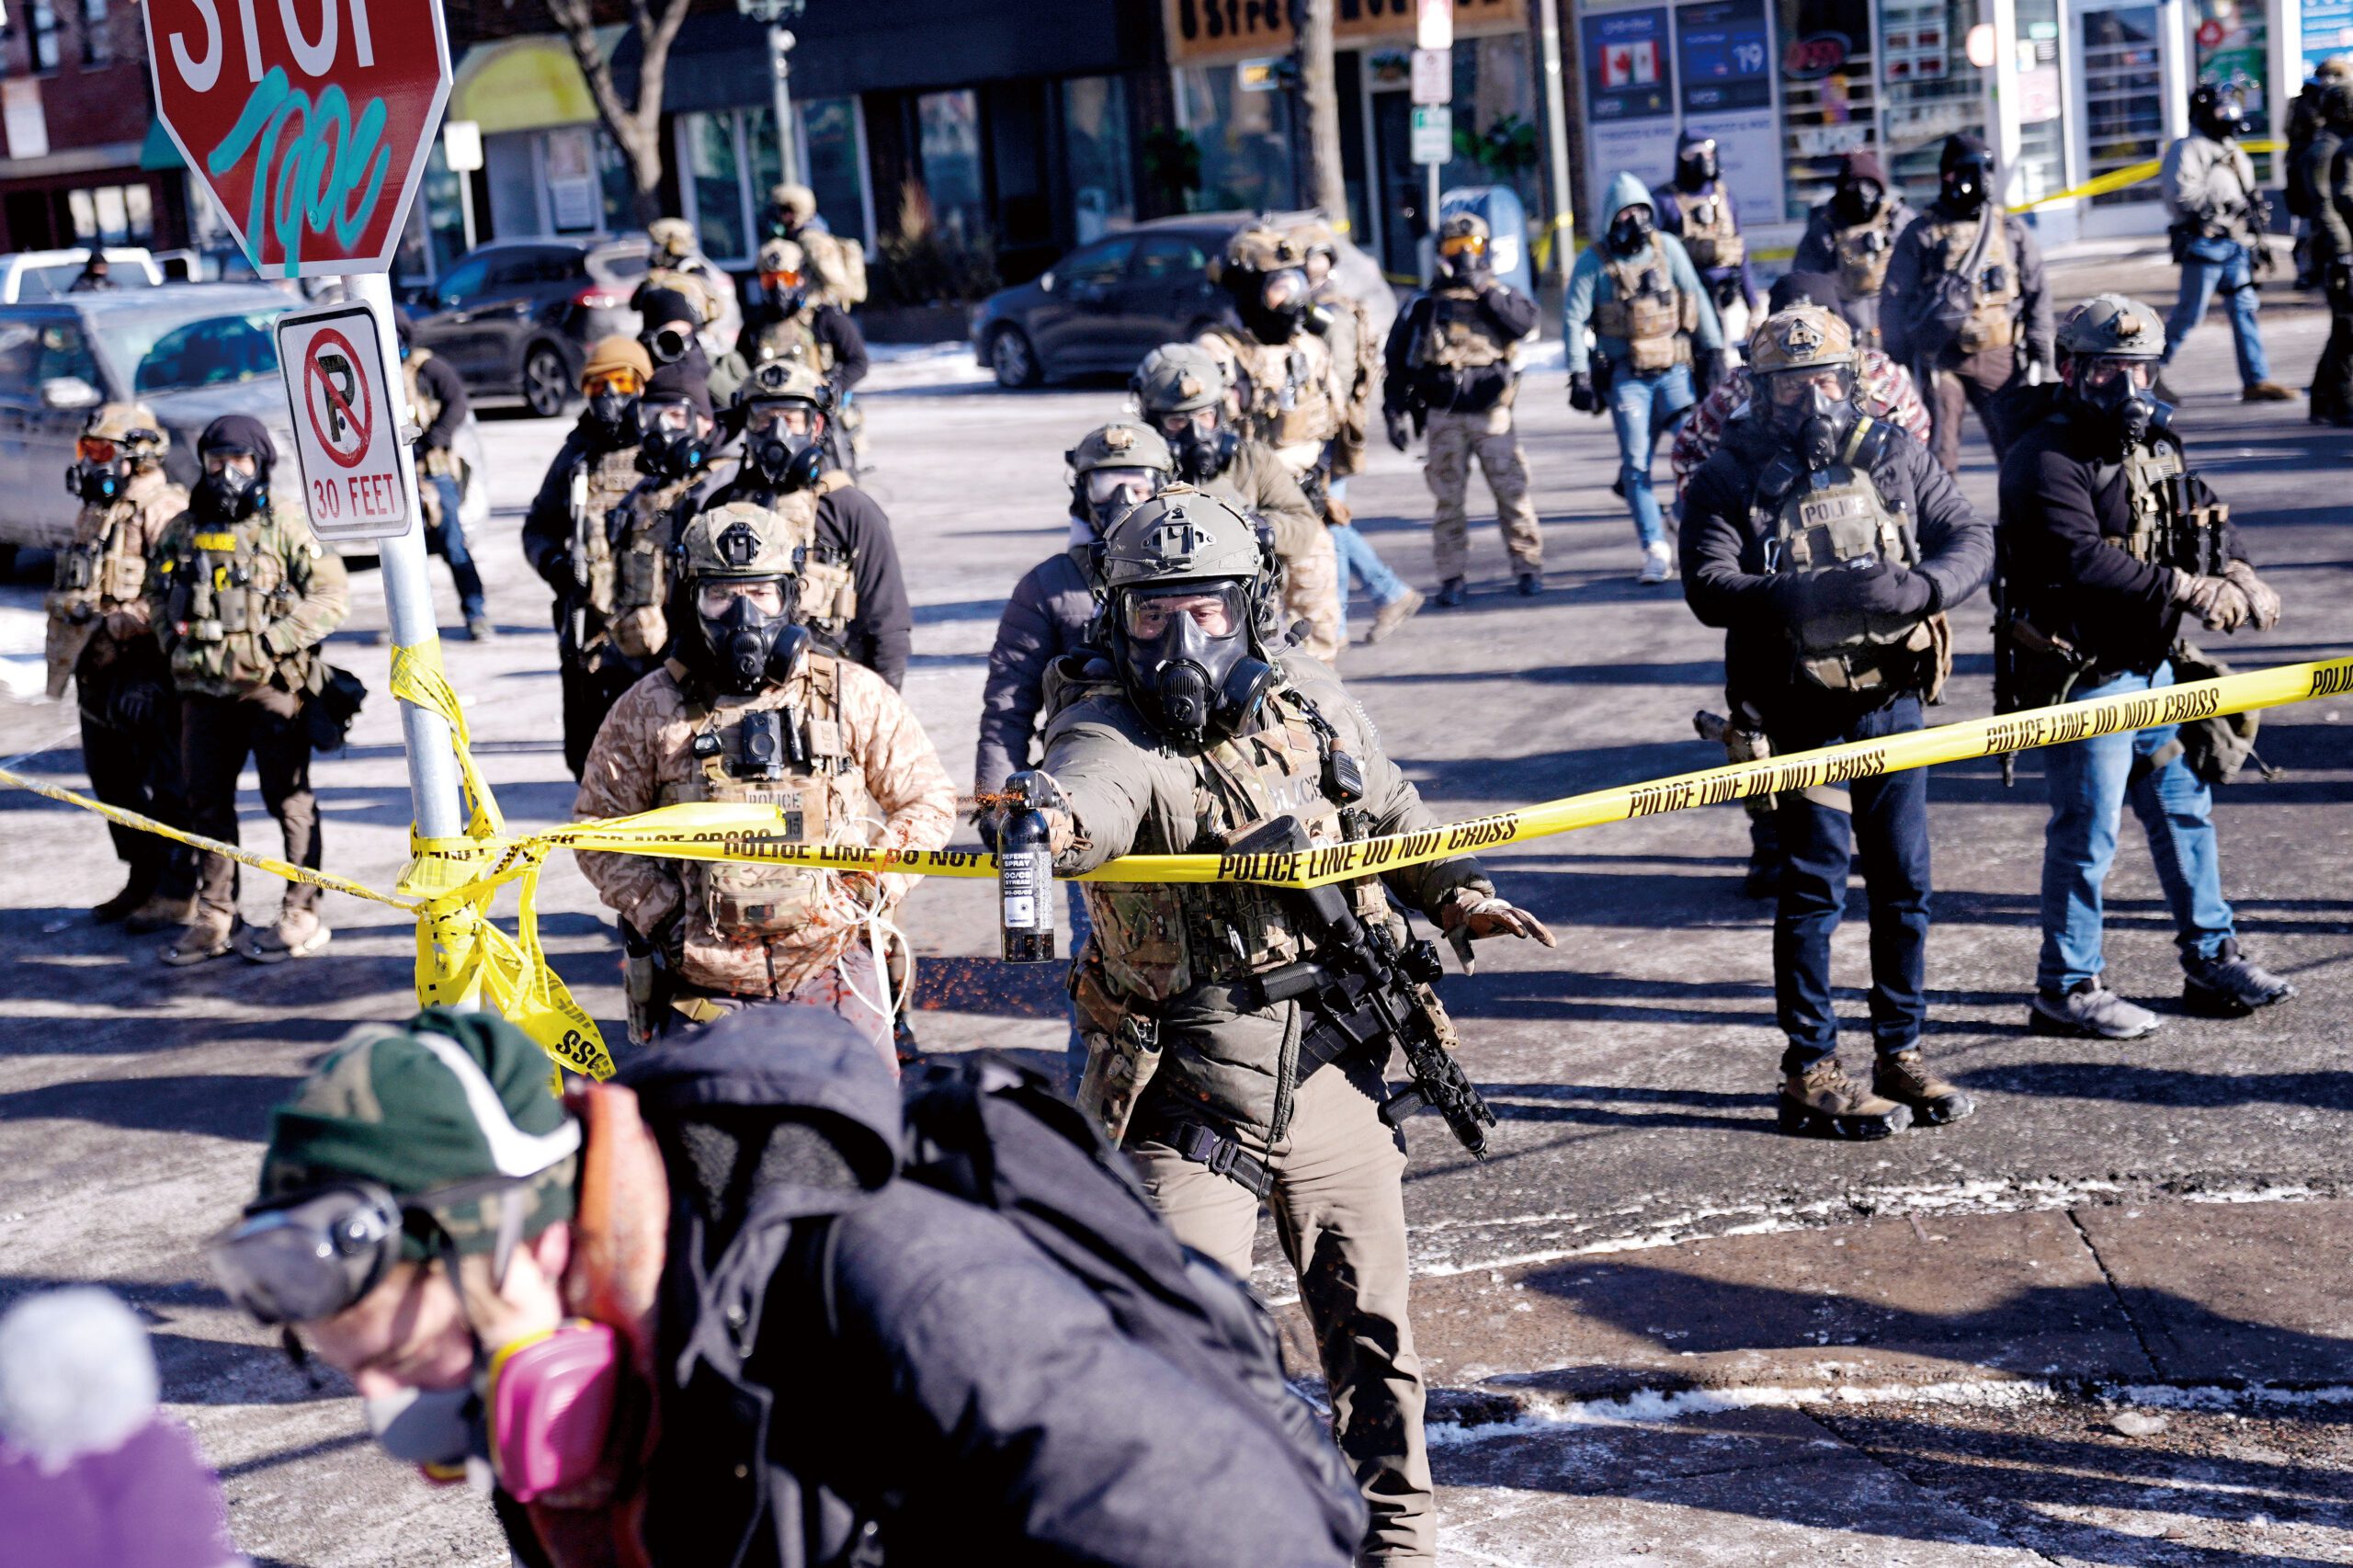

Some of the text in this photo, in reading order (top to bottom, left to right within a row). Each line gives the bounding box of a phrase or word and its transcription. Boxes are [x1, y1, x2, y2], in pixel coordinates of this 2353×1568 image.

[313, 473, 396, 519] 30 FEET
[1984, 687, 2220, 754] POLICE LINE DO NOT CROSS
[1627, 779, 1695, 818] POLICE
[1699, 770, 1744, 806] LINE
[1823, 749, 1885, 785] CROSS
[820, 845, 876, 862] LINE
[928, 850, 983, 869] NOT
[1217, 852, 1303, 881] POLICE
[1308, 843, 1358, 880] LINE
[1397, 826, 1444, 860] NOT
[1448, 812, 1519, 851] CROSS
